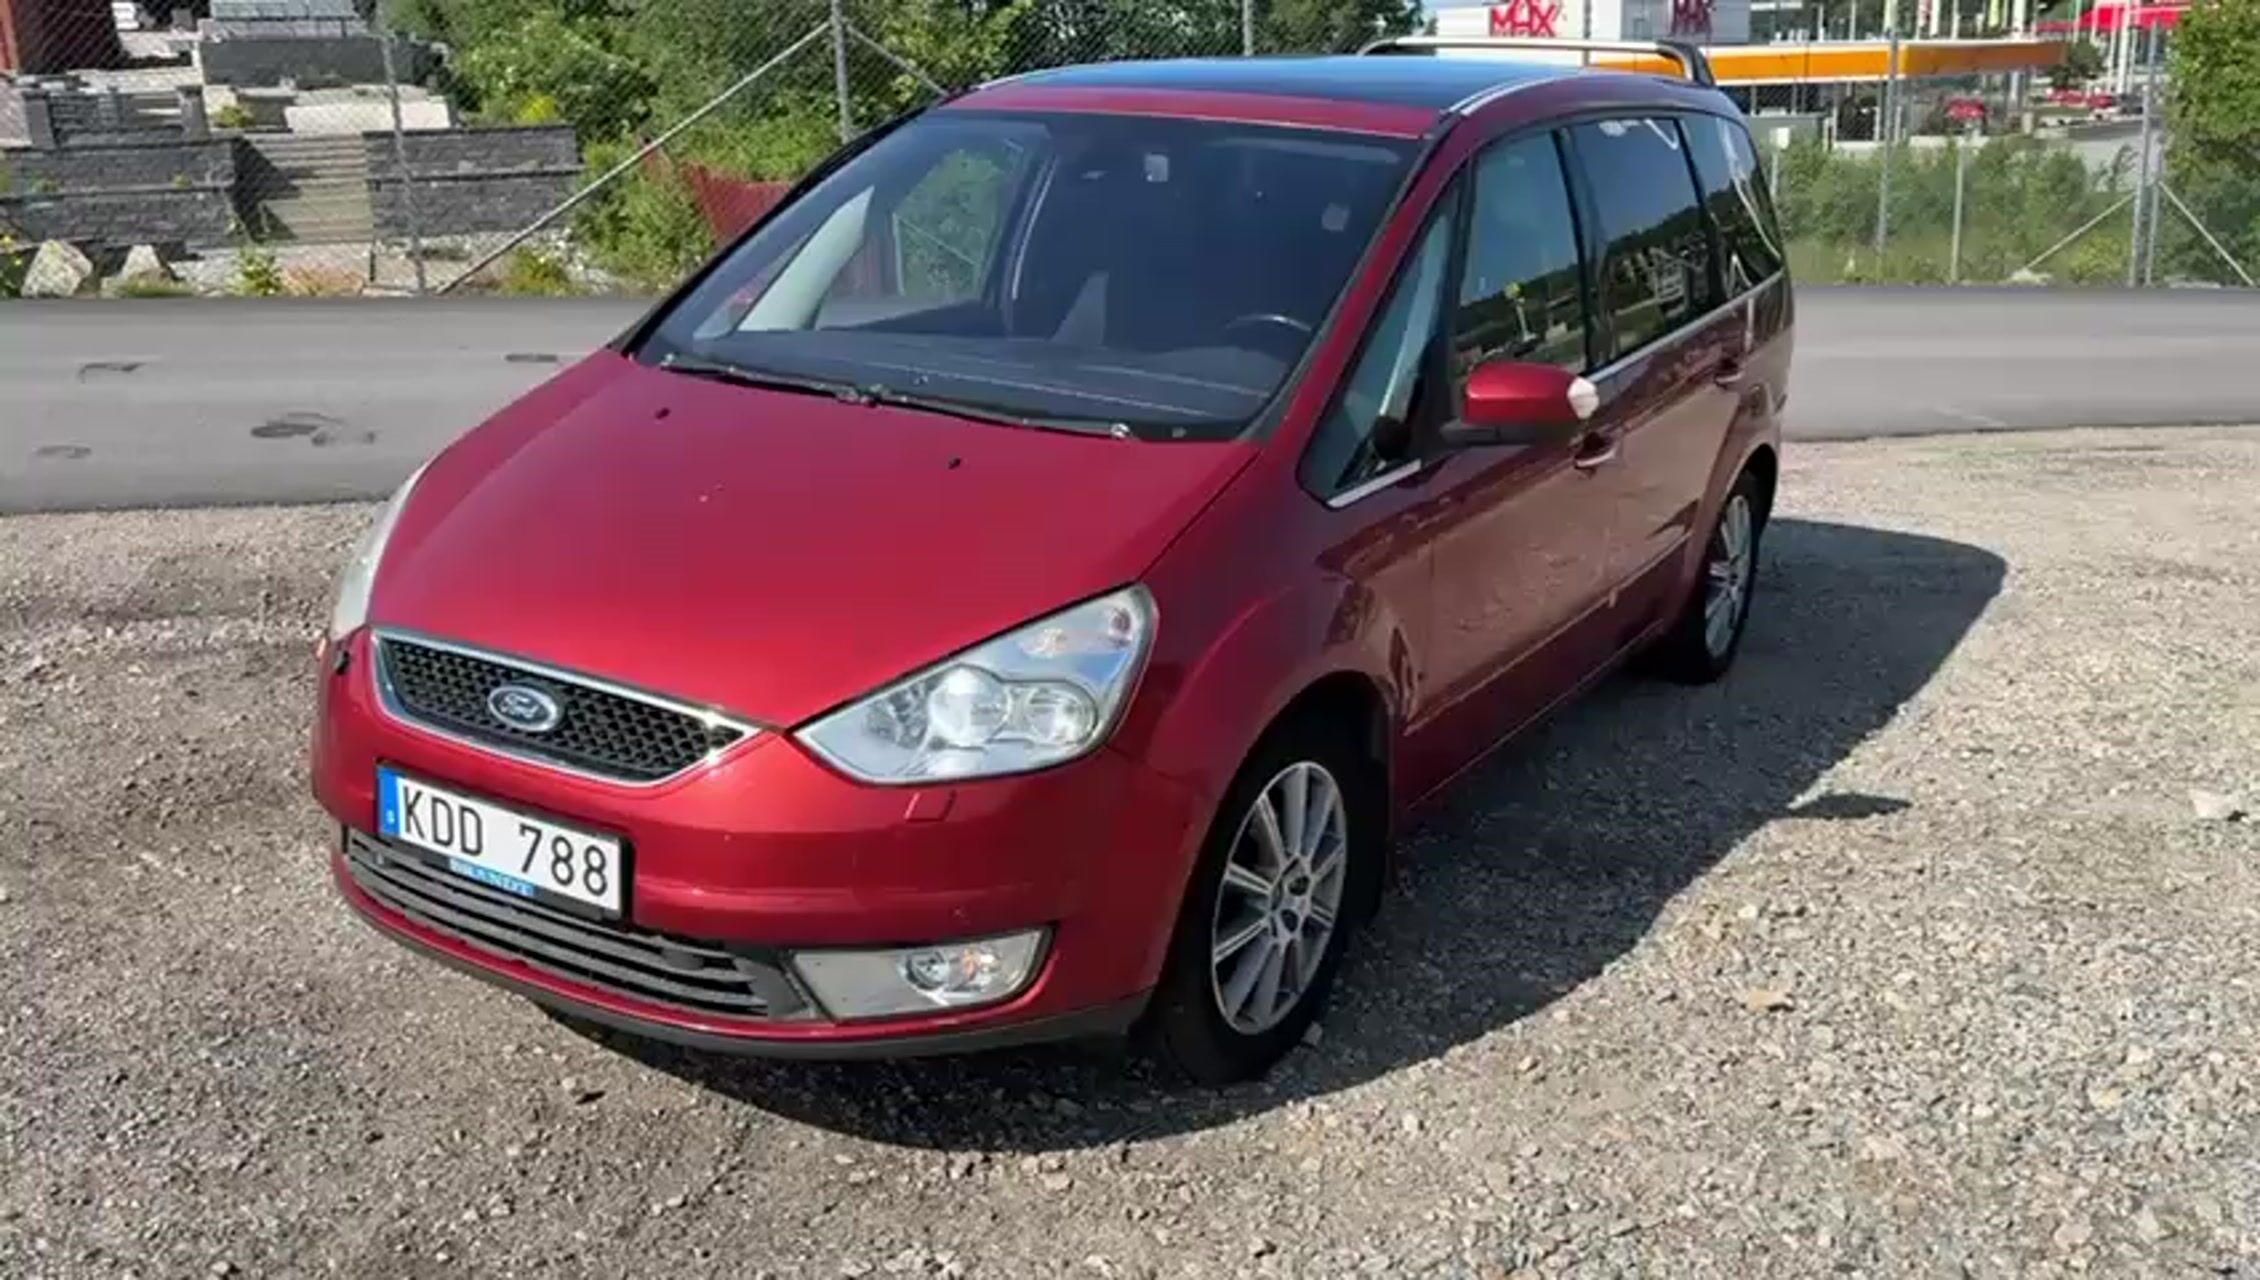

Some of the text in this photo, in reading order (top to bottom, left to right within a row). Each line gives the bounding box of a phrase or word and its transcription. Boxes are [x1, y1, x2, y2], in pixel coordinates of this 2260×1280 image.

[1489, 0, 1556, 37] MAX
[403, 785, 608, 896] KDD 788
